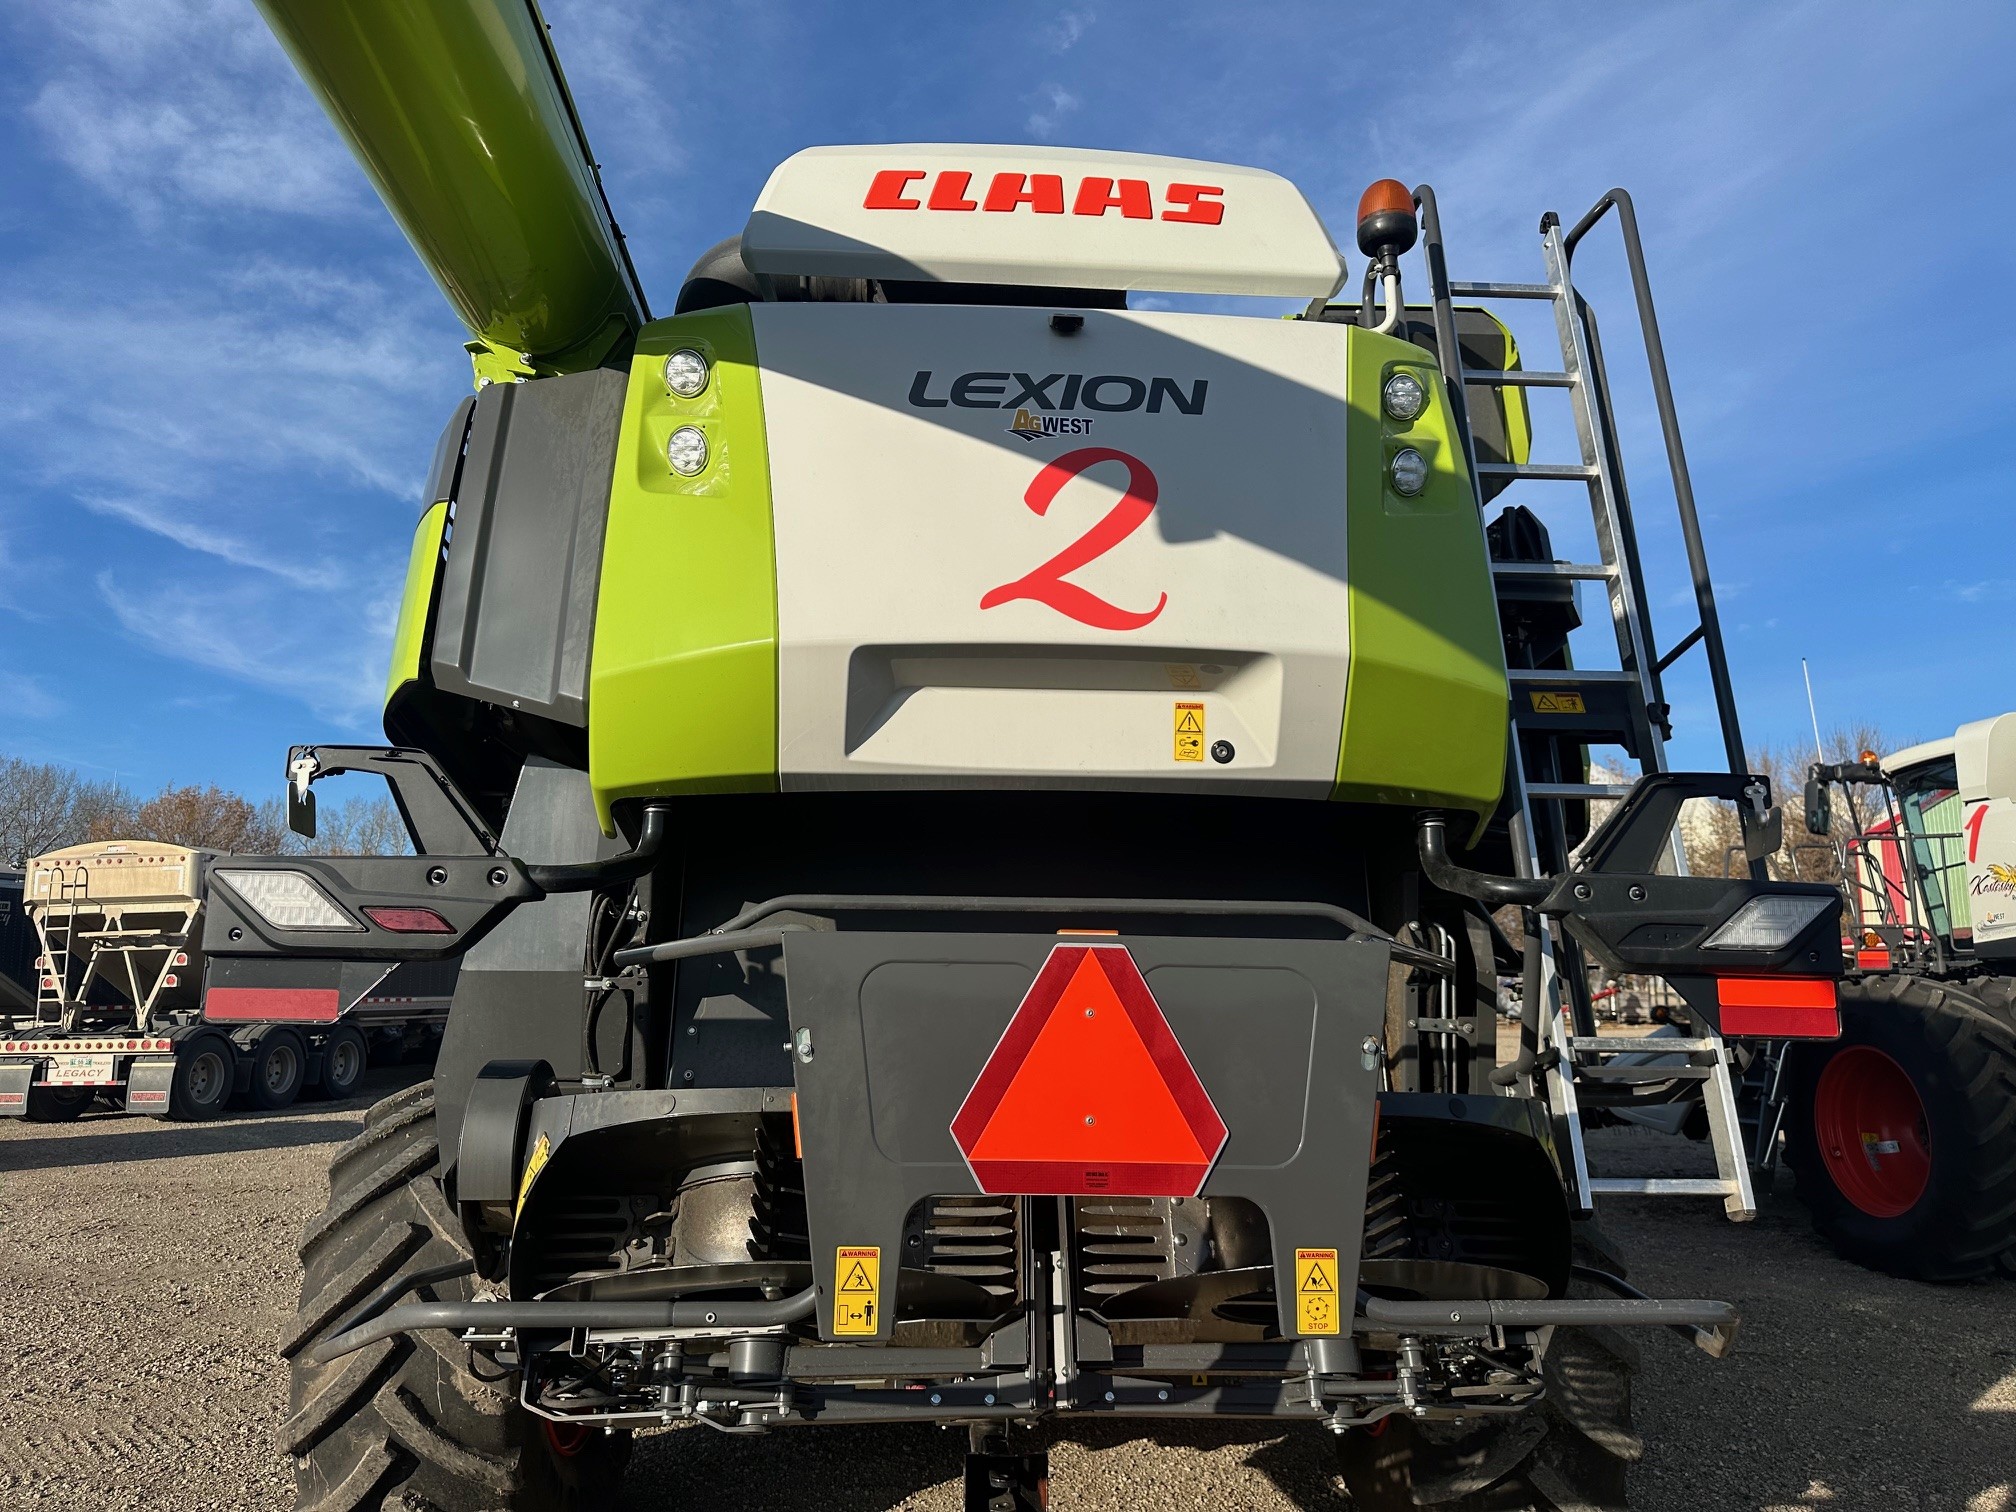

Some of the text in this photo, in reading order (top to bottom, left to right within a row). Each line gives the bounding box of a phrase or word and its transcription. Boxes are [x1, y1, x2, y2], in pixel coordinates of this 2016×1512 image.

[863, 170, 1225, 226] CLAAS
[908, 371, 1209, 416] LEXION
[979, 446, 1168, 631] 2
[1964, 804, 1990, 864] 1
[56, 1069, 104, 1077] LEGACY
[1308, 1322, 1329, 1330] STOP
